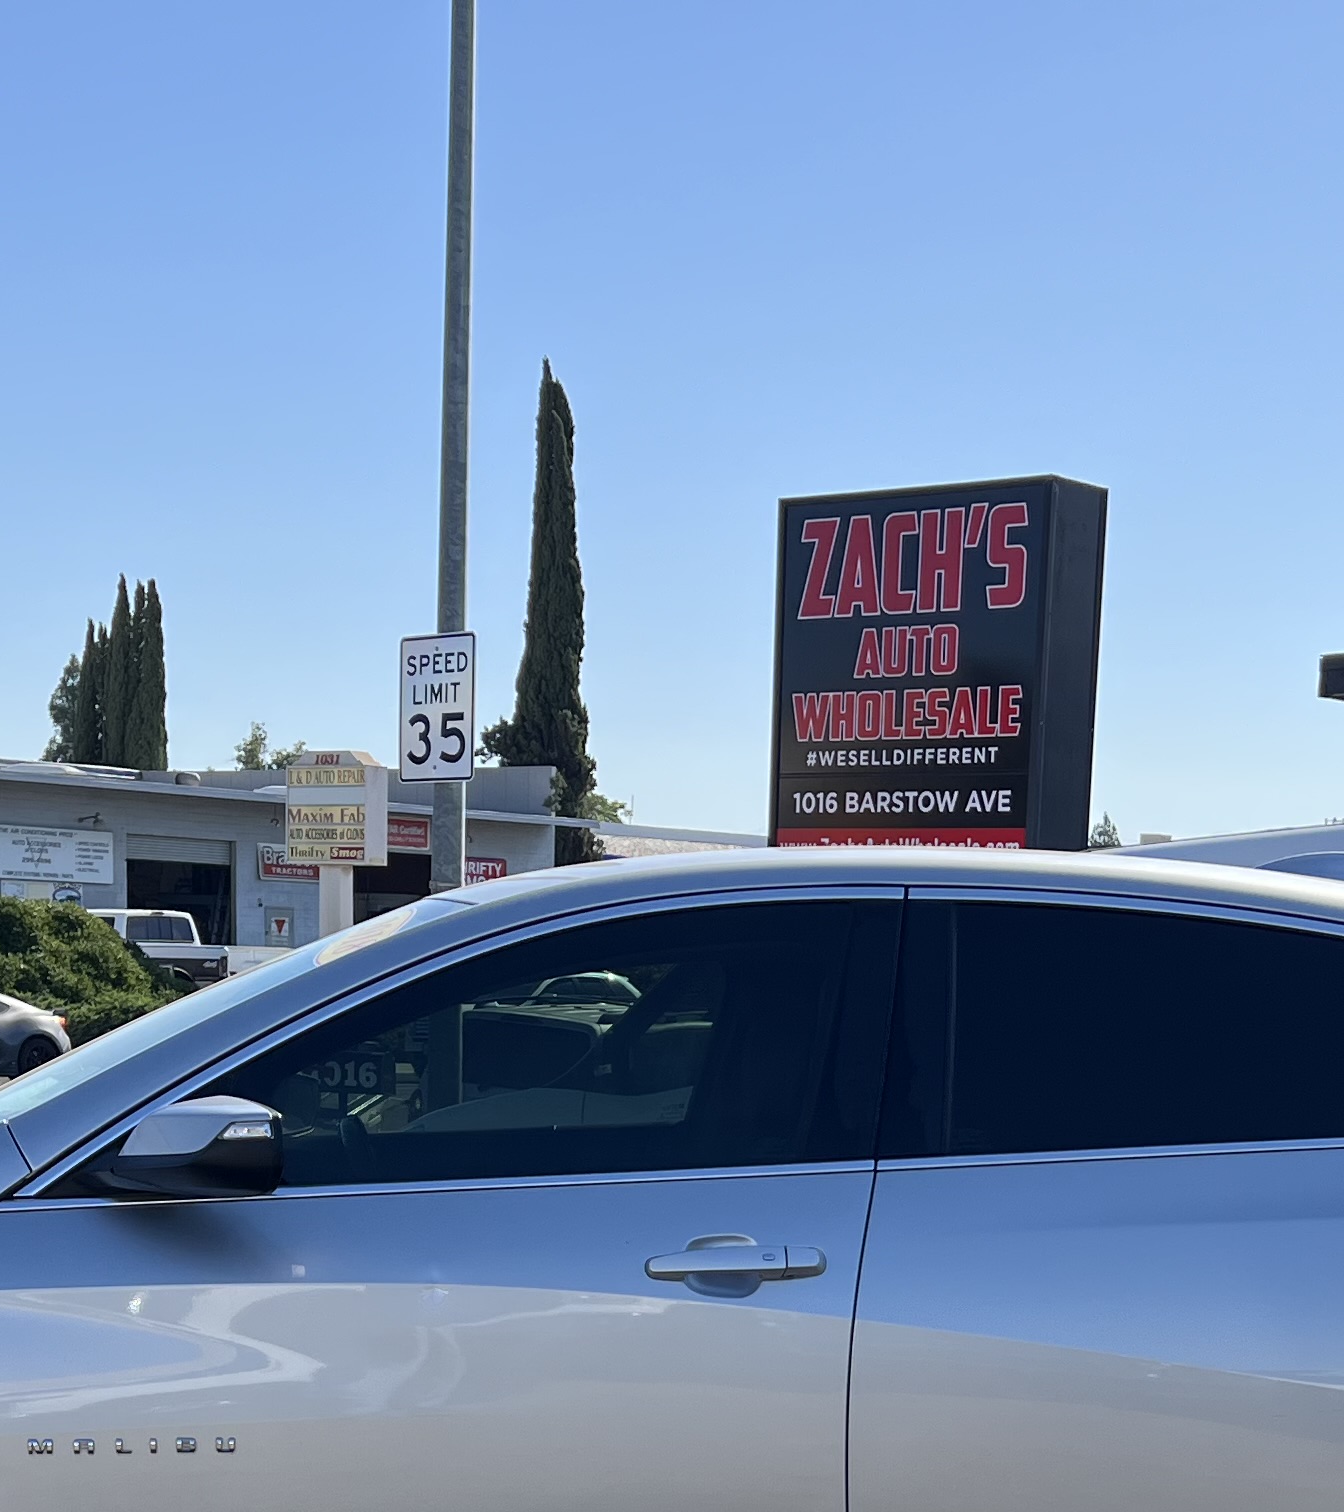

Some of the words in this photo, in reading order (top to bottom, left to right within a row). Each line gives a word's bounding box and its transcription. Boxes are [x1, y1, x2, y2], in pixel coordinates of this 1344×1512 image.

[797, 502, 1028, 620] ZACH'S
[854, 624, 959, 678] AUTO
[406, 652, 468, 676] SPEED
[412, 682, 461, 705] LIMIT
[792, 685, 1023, 741] WHOLESALE
[406, 712, 466, 765] 35
[314, 754, 341, 765] 1031
[806, 747, 999, 766] #WESELLDIFFERENT
[306, 770, 312, 784] D
[314, 770, 336, 784] AUTO
[337, 769, 365, 784] REPAIR
[793, 792, 838, 814] 1016
[845, 791, 959, 814] BARSTOW
[965, 790, 1012, 813] AVE
[290, 828, 304, 840] AUTO
[330, 847, 364, 859] Smog
[271, 867, 314, 876] TRACTORS
[27, 1436, 236, 1454] MALIBU
